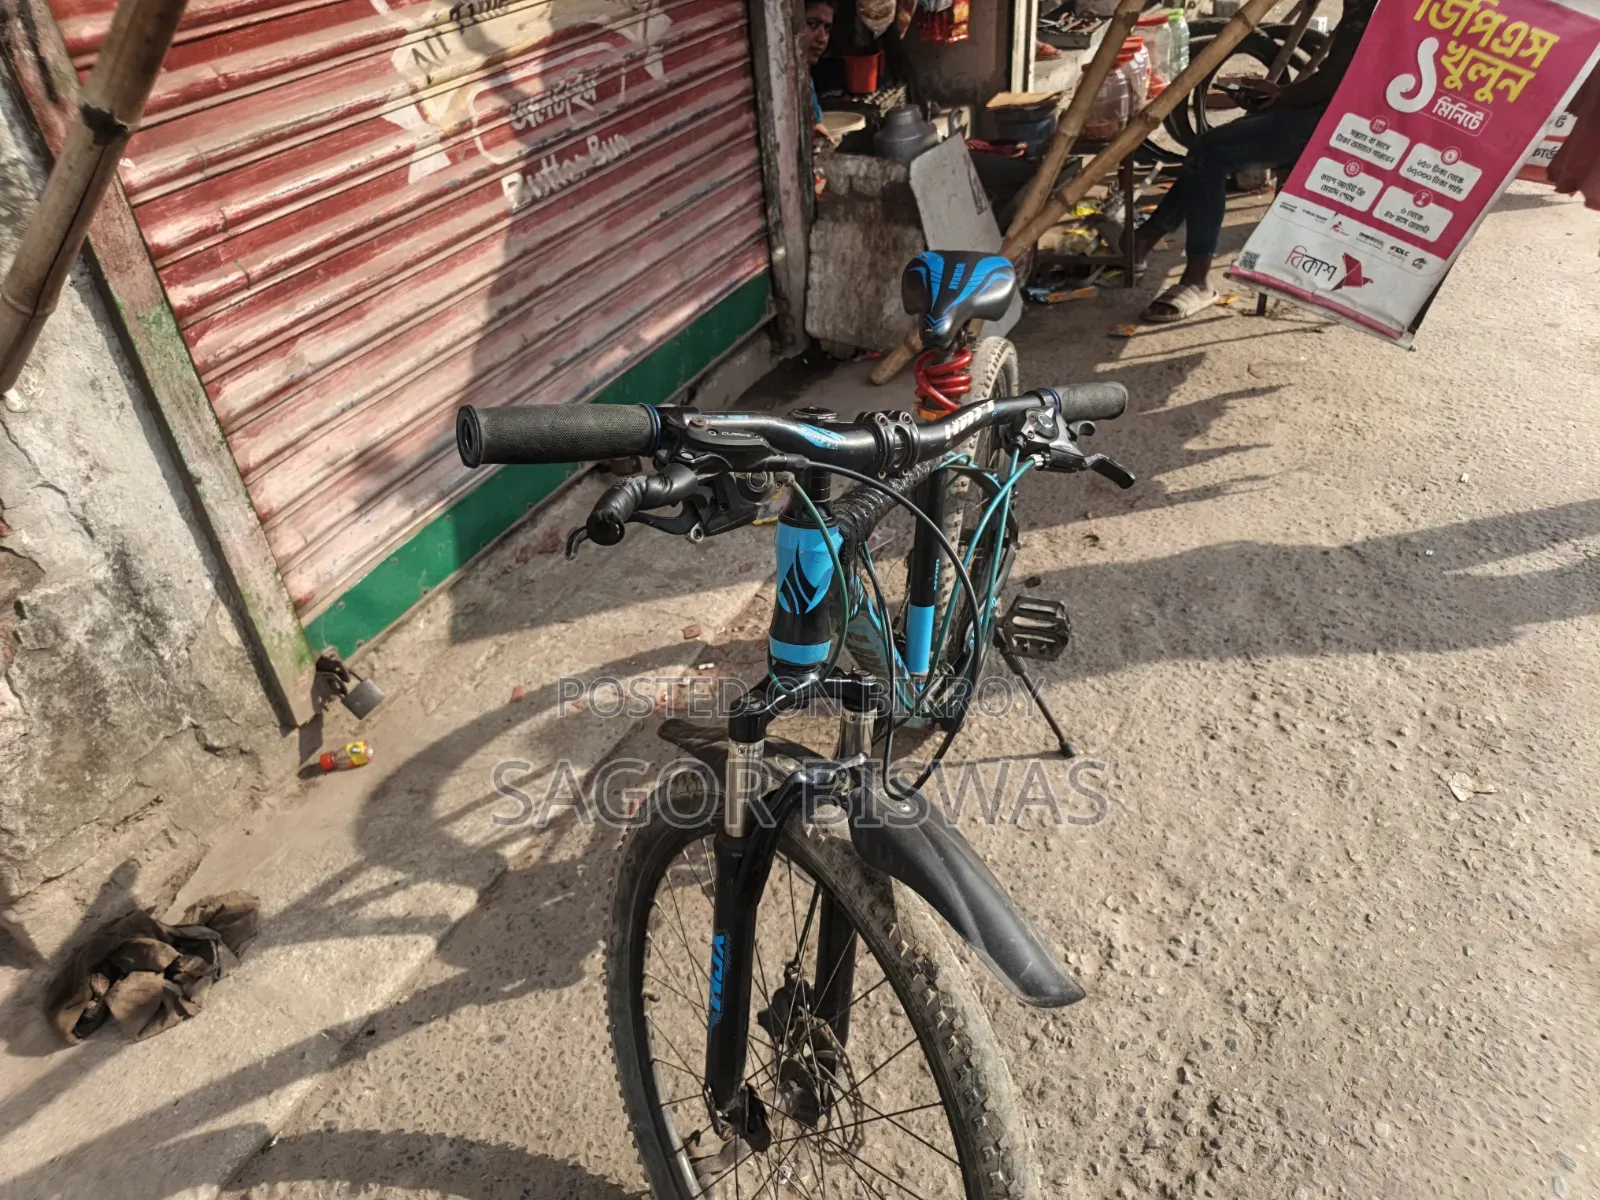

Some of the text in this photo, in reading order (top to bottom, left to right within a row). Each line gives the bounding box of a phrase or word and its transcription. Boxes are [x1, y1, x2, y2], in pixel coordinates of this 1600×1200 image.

[1386, 37, 1485, 131] ১ মিনিটে
[1440, 40, 1536, 104] খুলুন
[1284, 245, 1338, 282] বিকাশ
